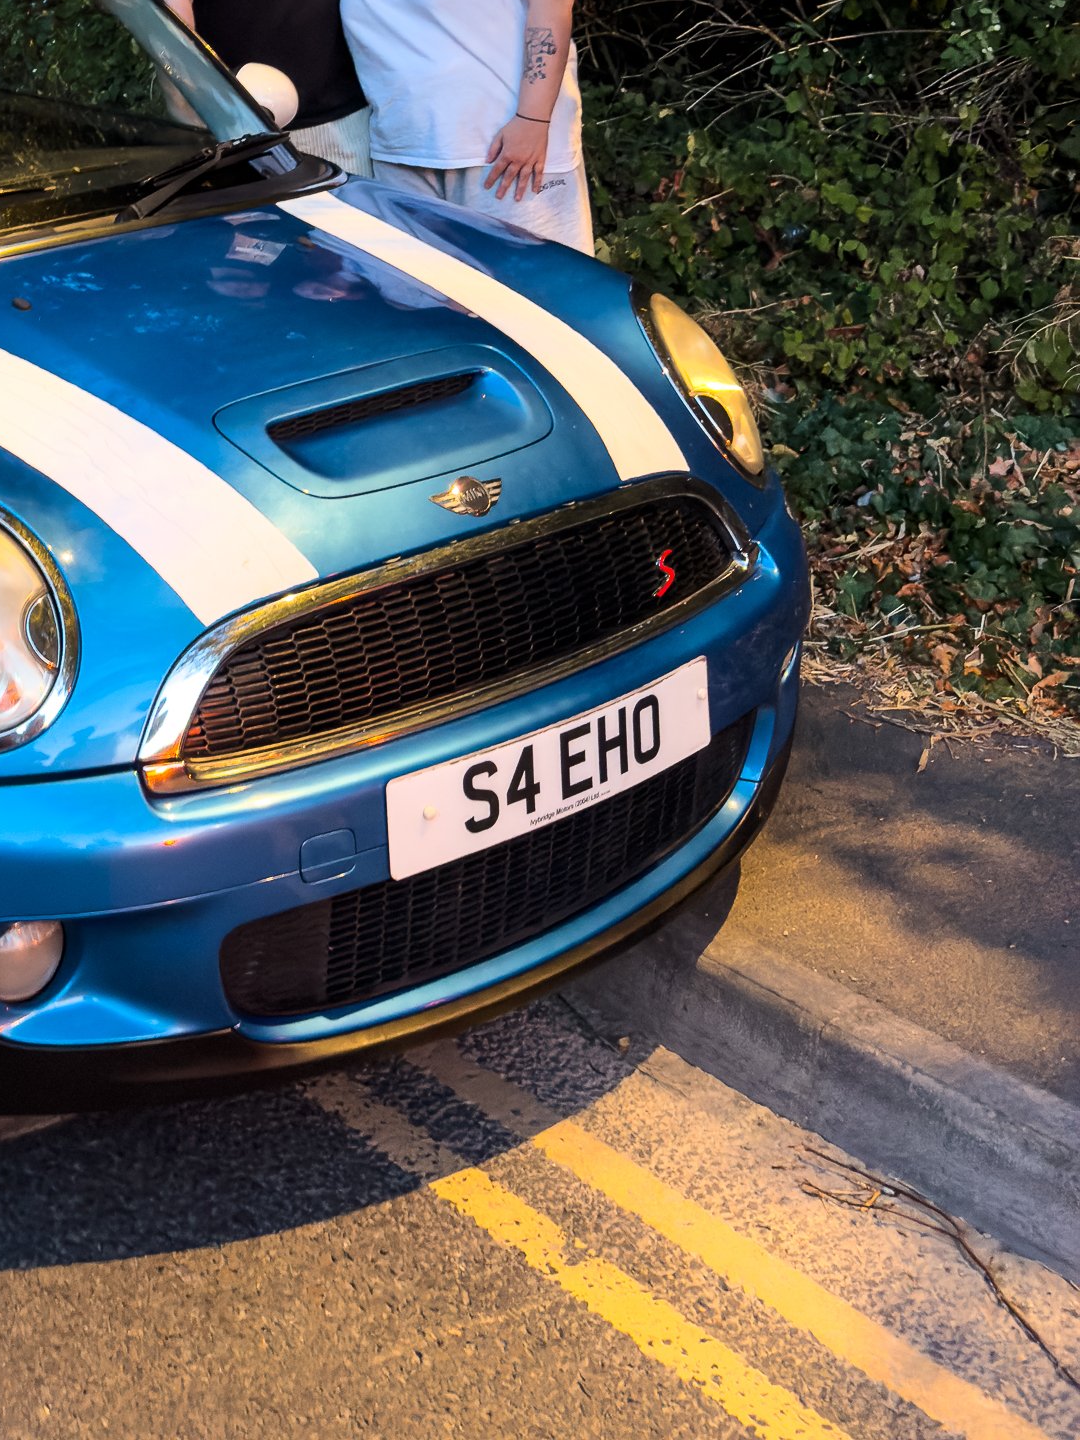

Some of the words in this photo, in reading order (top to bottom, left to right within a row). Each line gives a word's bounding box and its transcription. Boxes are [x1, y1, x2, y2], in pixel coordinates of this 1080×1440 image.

[652, 548, 676, 598] S
[462, 744, 541, 834] S4
[559, 694, 660, 800] EHO
[529, 811, 555, 826] Ivybridge
[556, 804, 575, 816] Motors
